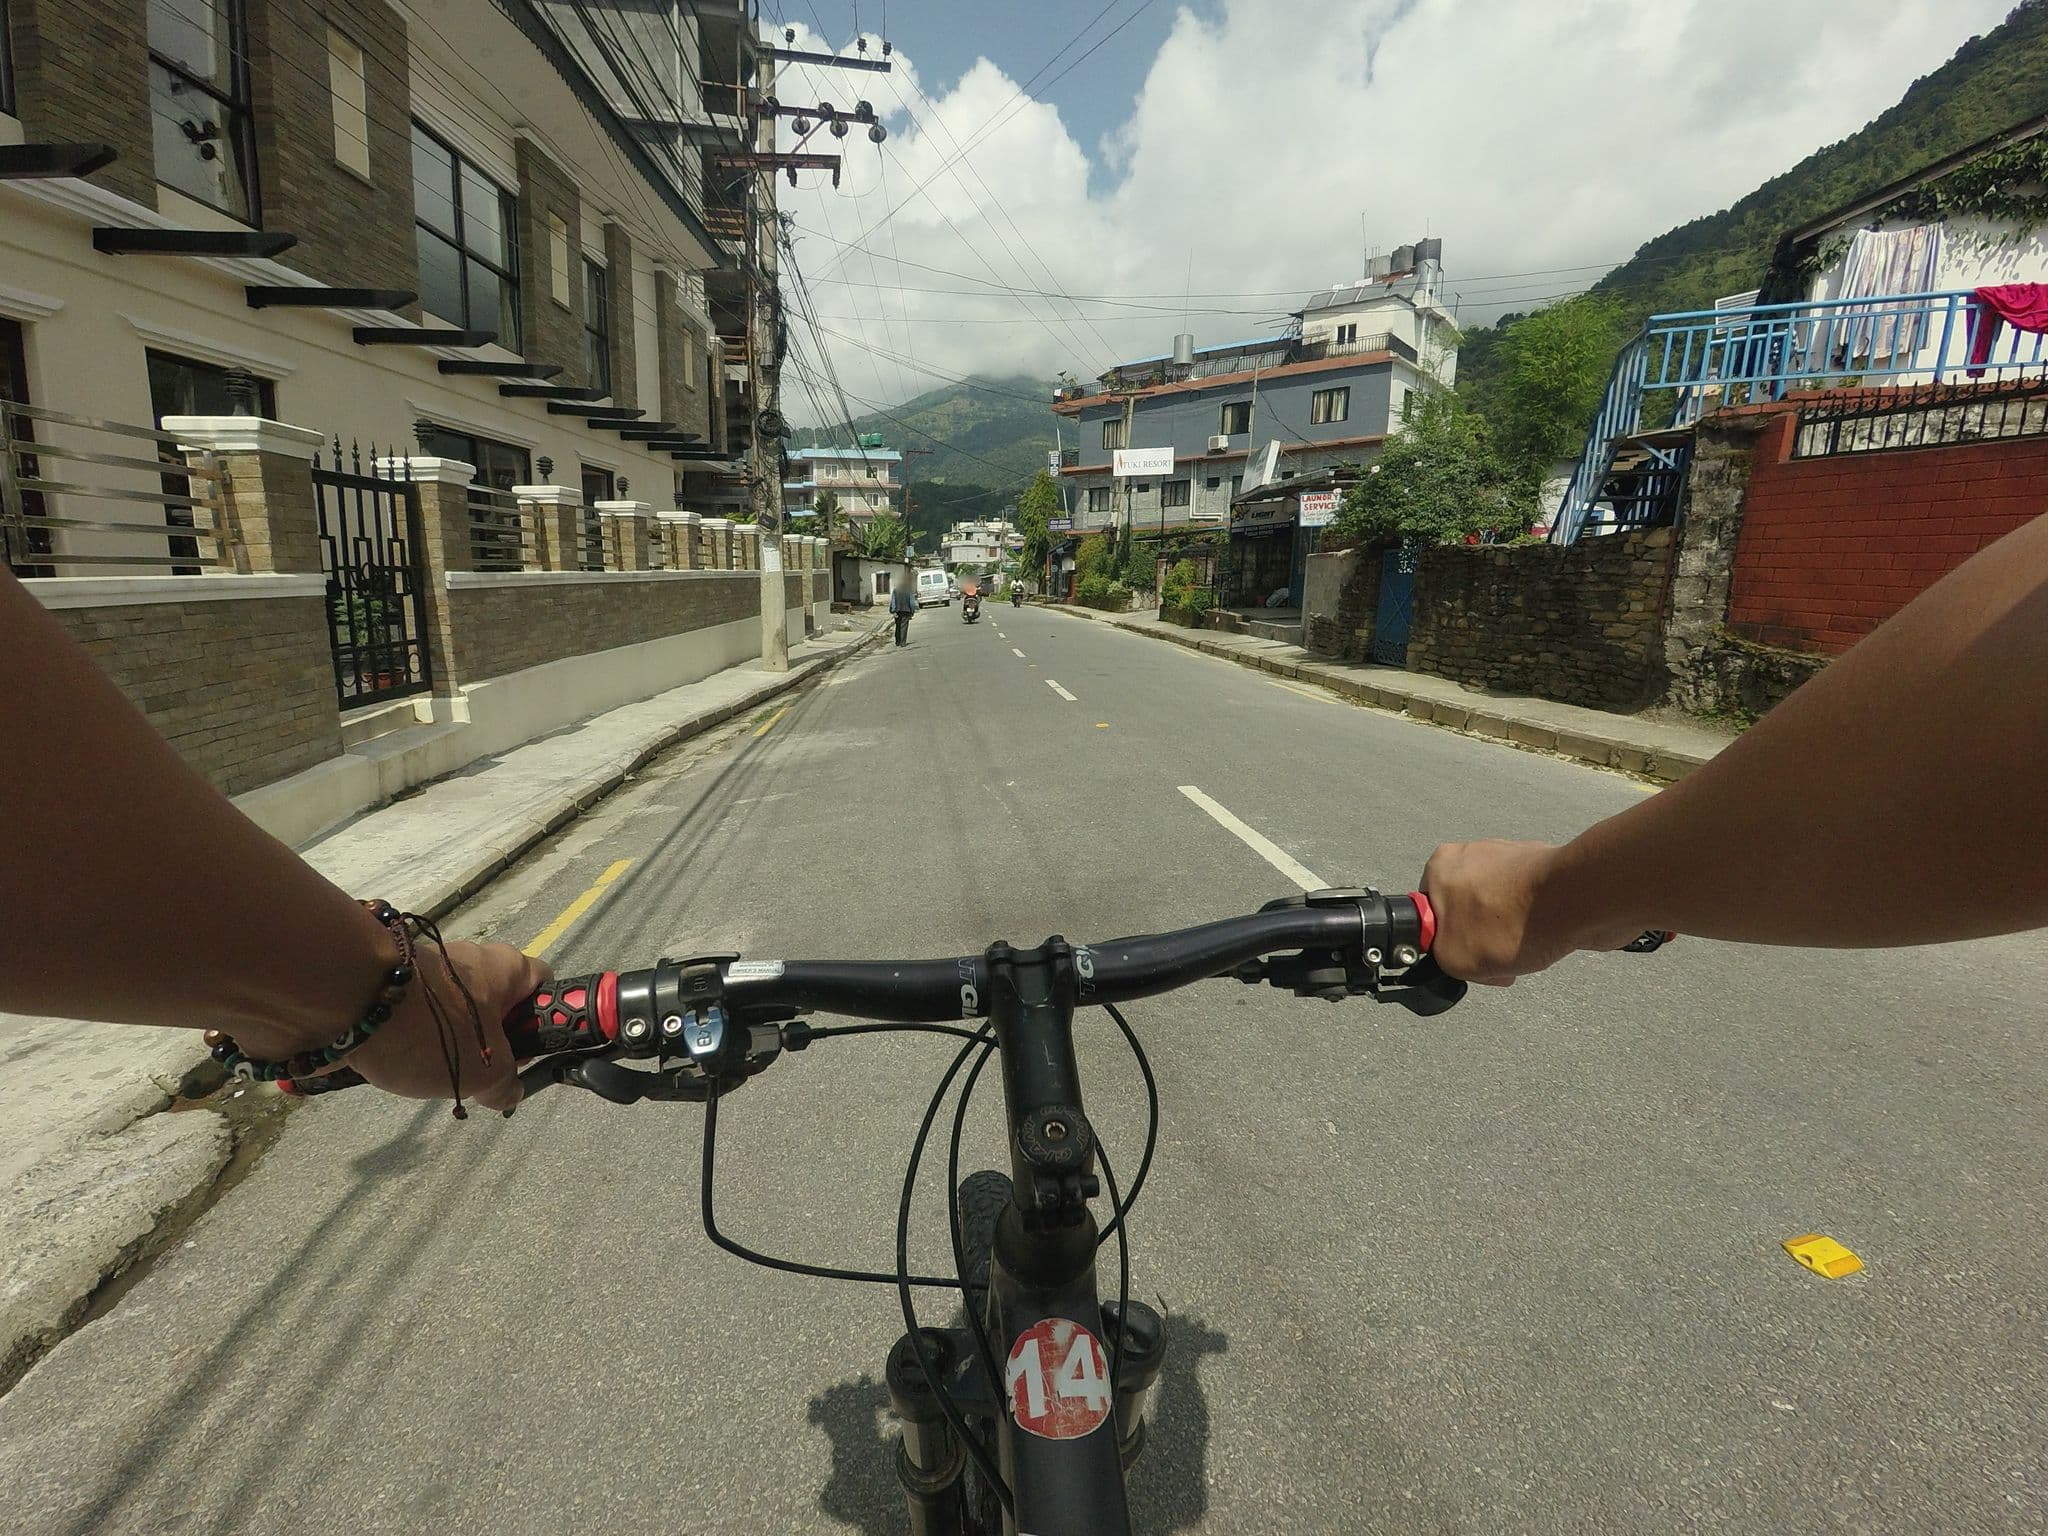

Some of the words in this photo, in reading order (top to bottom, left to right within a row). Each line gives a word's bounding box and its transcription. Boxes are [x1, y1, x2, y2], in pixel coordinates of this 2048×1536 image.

[1143, 459, 1171, 468] RESORT
[1304, 502, 1337, 511] SERVICE
[1006, 1334, 1107, 1418] 14
